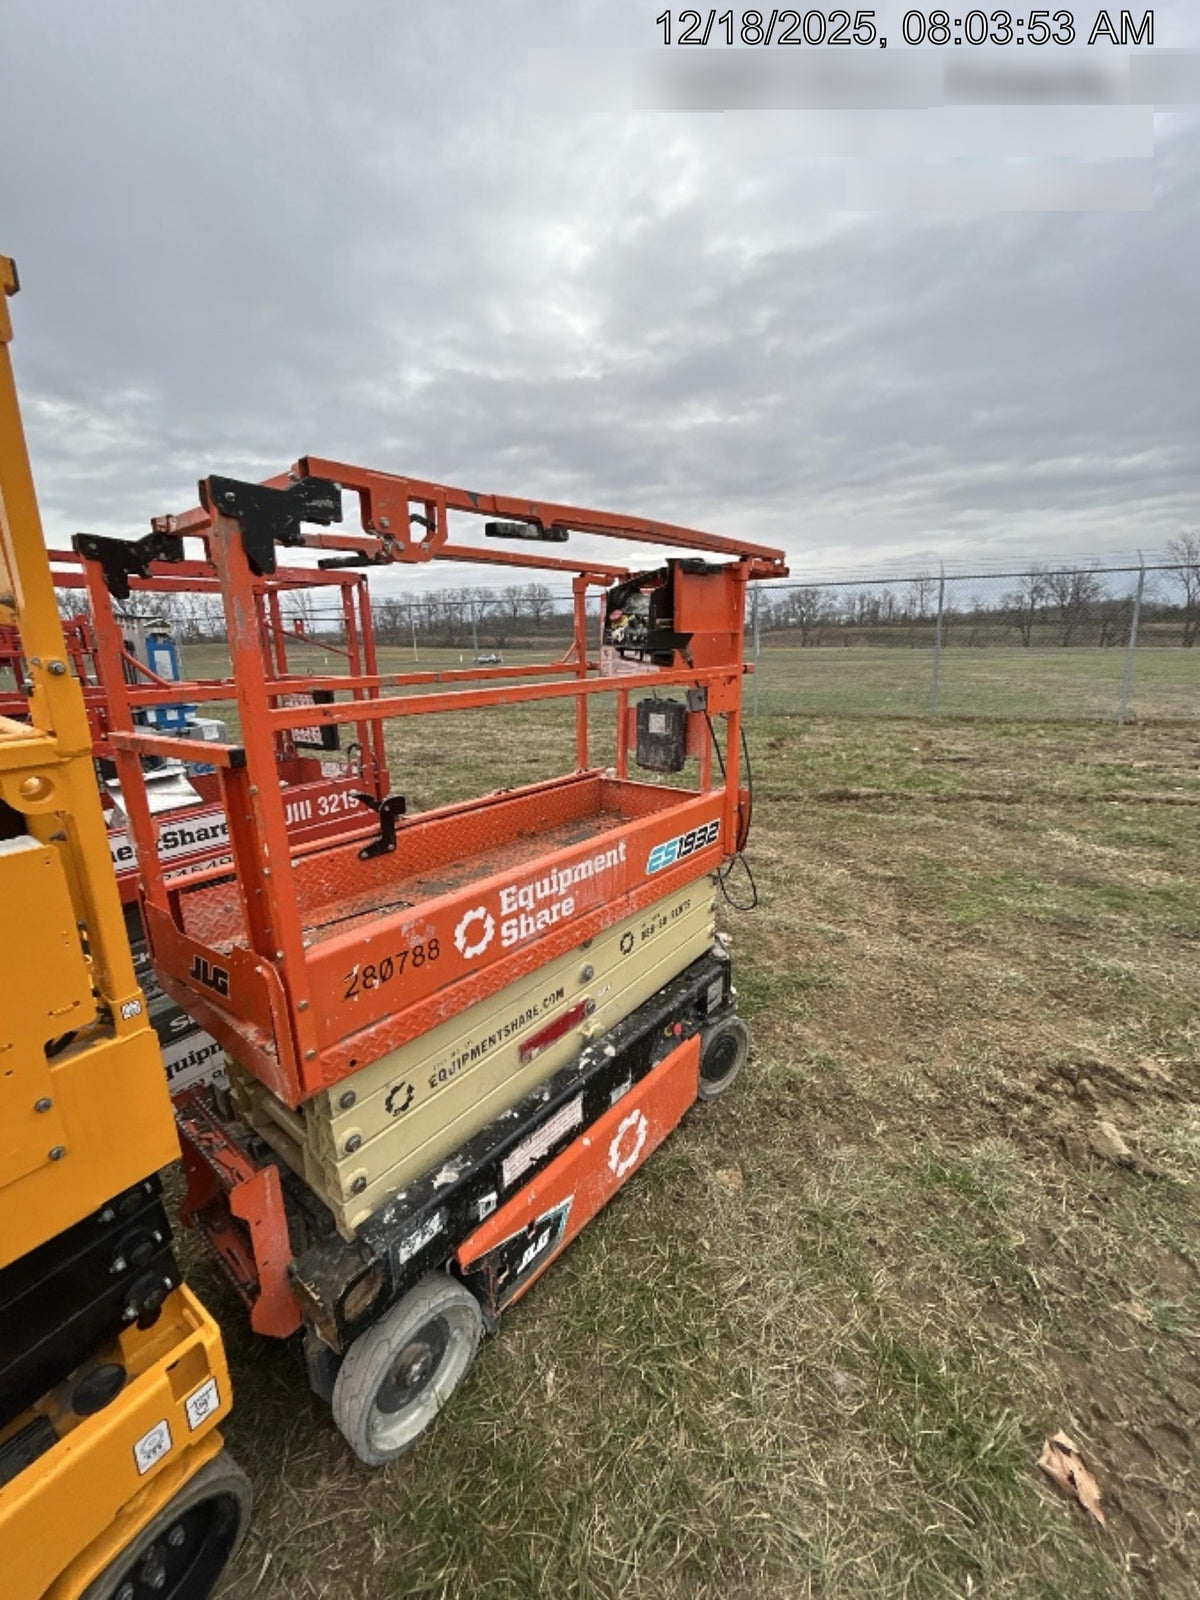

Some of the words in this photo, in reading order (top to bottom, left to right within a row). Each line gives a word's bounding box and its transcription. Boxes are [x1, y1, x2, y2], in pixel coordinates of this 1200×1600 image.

[647, 820, 721, 875] ES1932
[499, 840, 627, 915] Equipment
[501, 896, 575, 948] Share
[190, 955, 231, 999] JLG
[343, 938, 441, 1000] 280788
